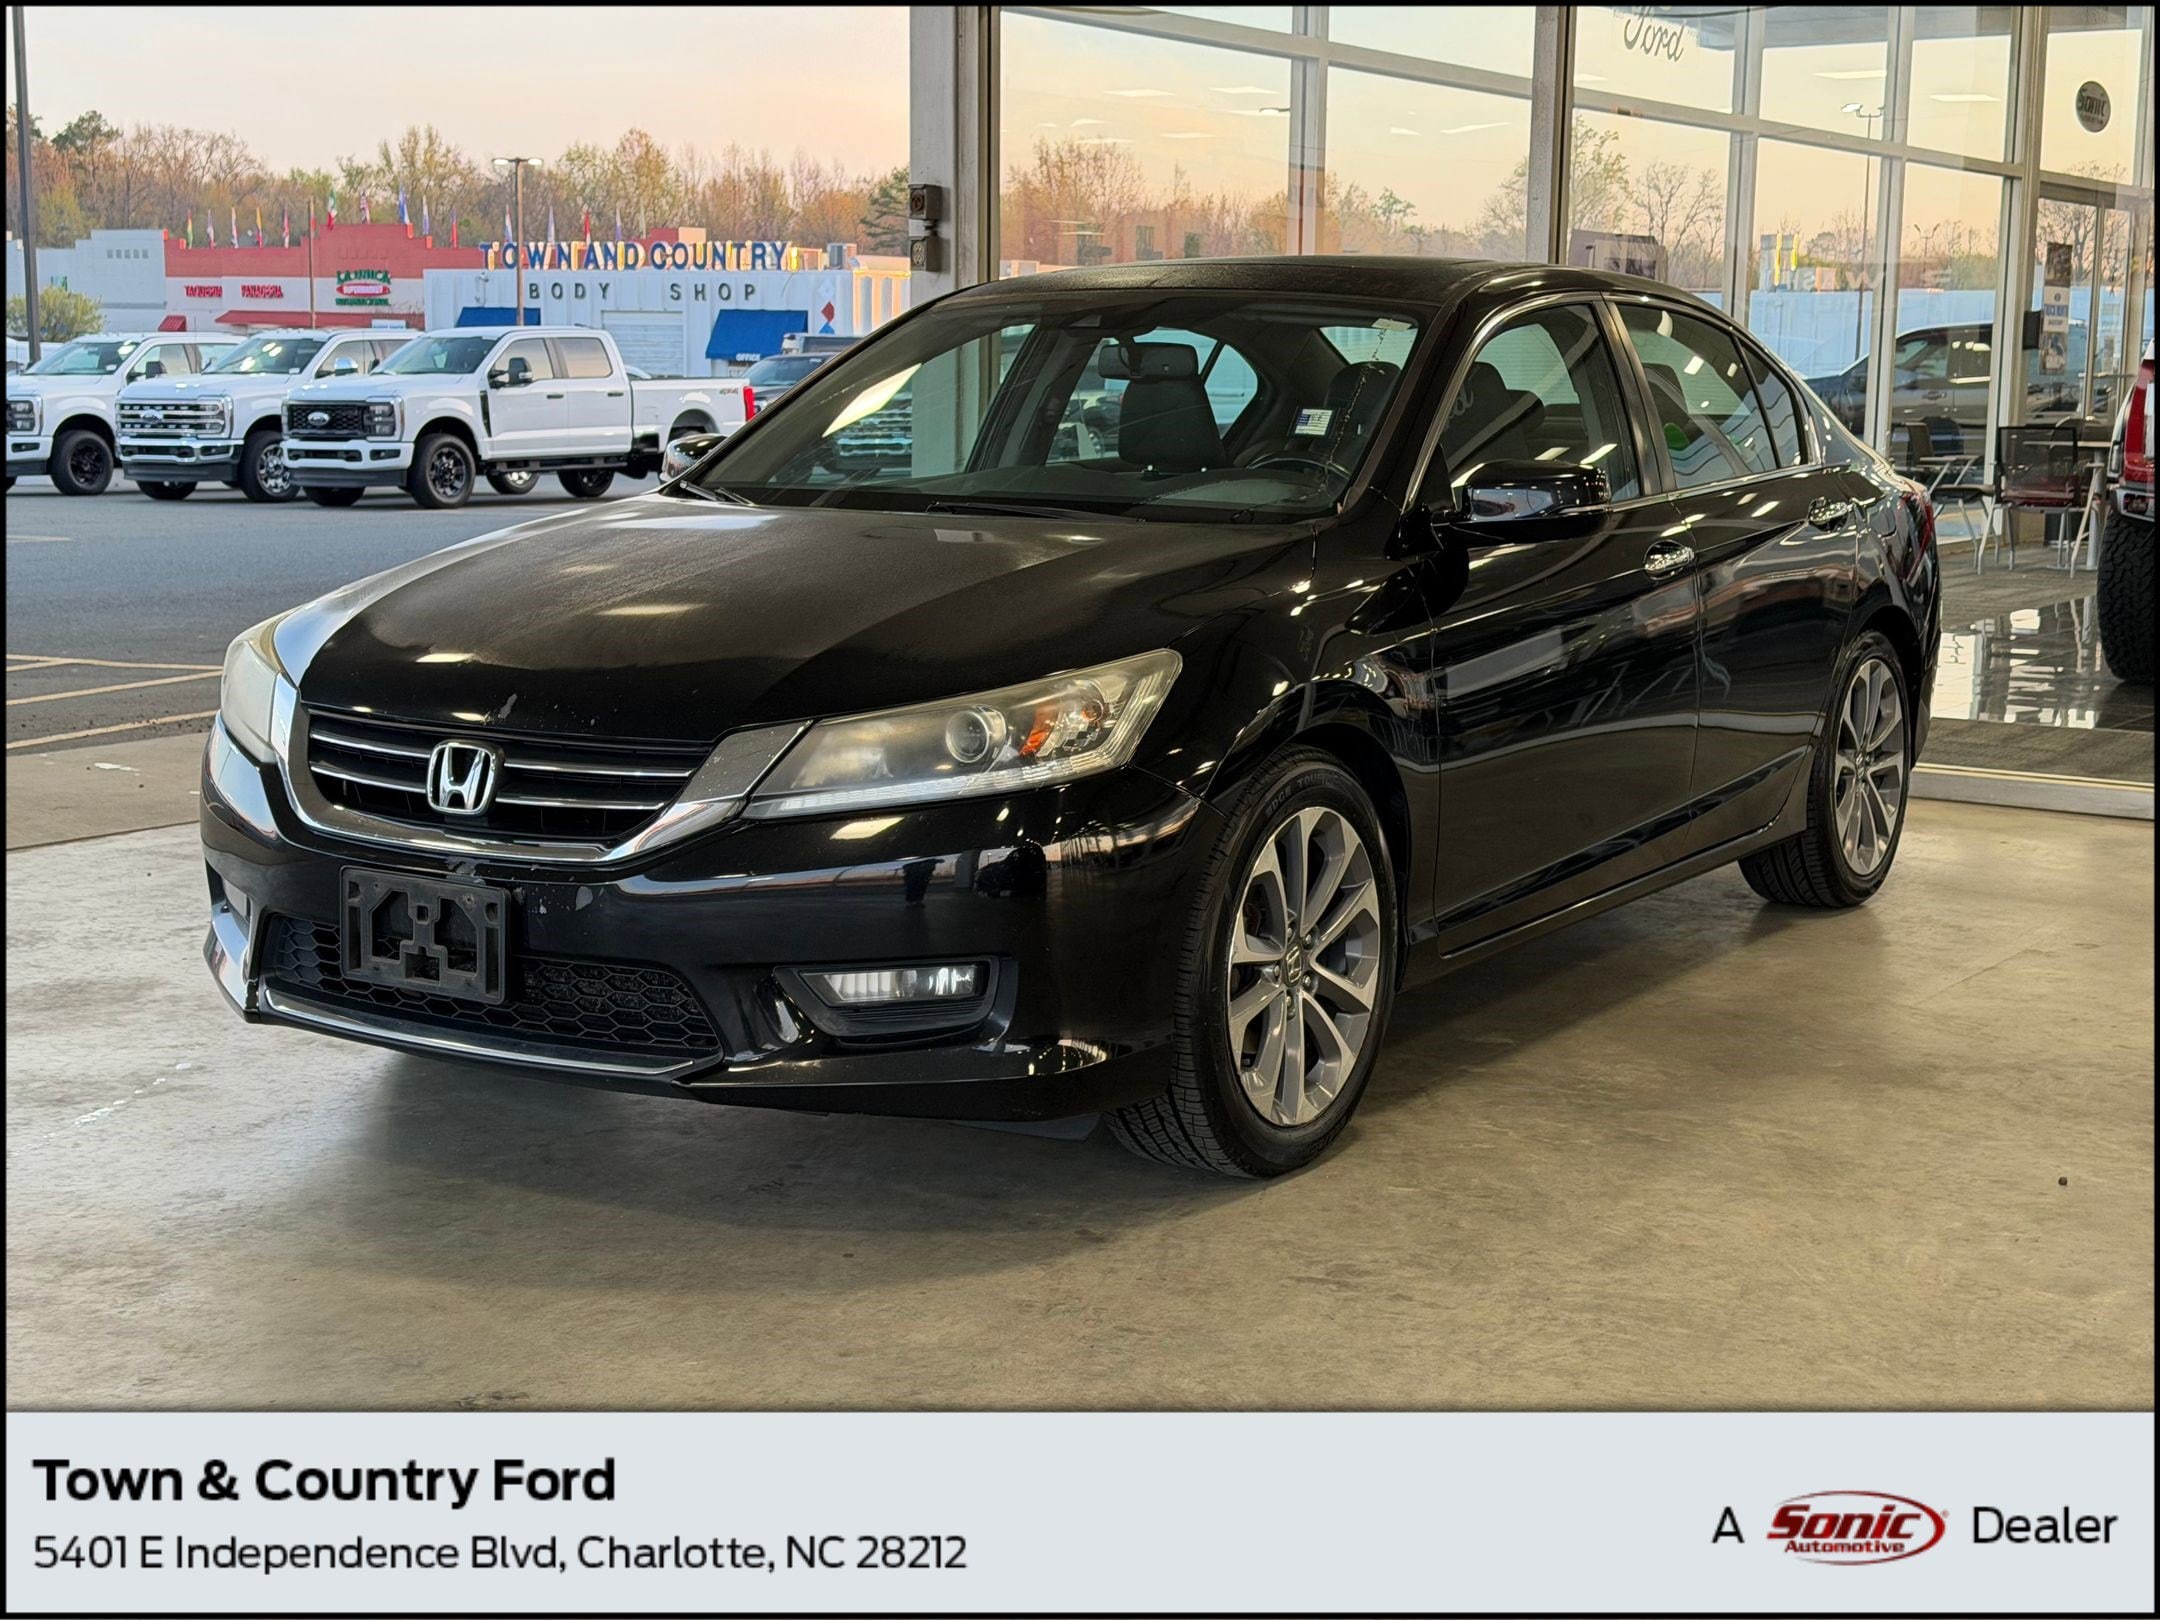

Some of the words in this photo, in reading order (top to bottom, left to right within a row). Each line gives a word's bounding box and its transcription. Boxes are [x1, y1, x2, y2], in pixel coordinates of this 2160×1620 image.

[480, 241, 578, 272] TOWN
[583, 241, 646, 272] AND
[650, 240, 791, 272] COUNTRY
[529, 283, 610, 300] BODY
[670, 283, 756, 301] SHOP
